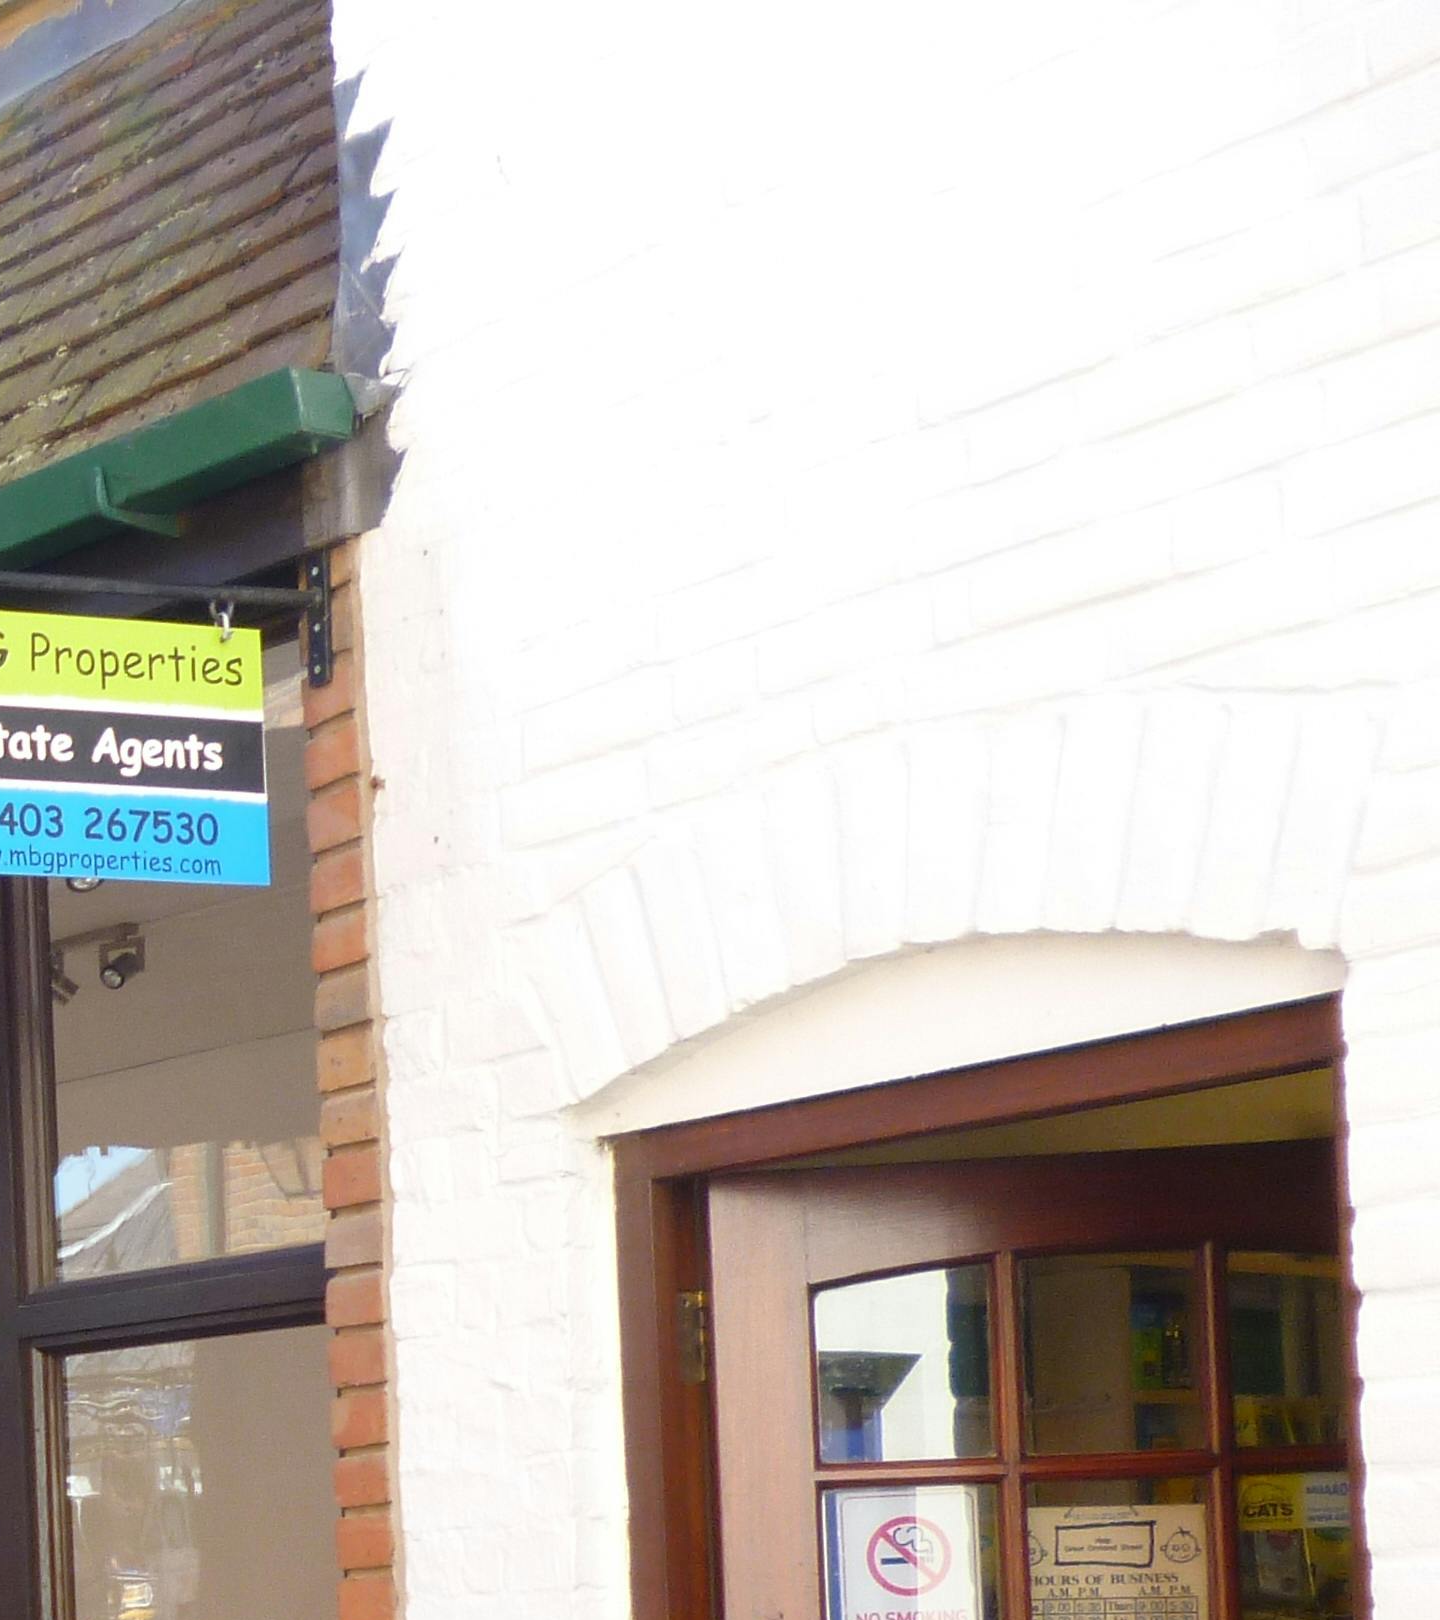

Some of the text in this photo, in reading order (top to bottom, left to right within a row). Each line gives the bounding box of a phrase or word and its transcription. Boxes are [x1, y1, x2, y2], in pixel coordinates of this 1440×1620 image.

[30, 632, 243, 690] Properties
[91, 726, 224, 777] Agents
[83, 806, 220, 846] 267530
[1110, 1572, 1180, 1585] BUSINESS
